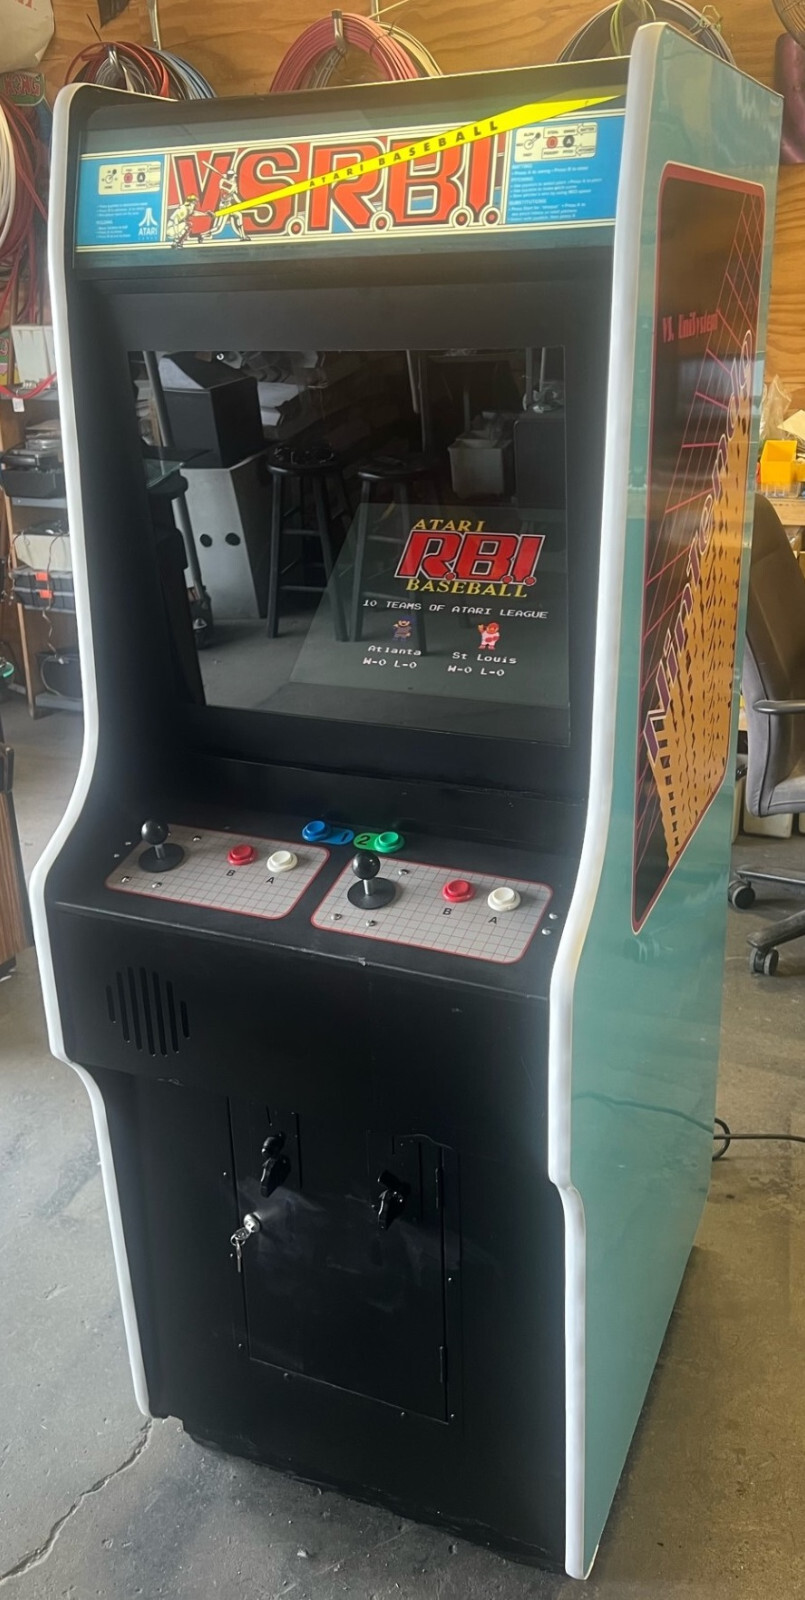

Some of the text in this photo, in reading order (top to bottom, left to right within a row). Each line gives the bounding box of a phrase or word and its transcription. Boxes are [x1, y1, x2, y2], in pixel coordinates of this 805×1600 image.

[309, 120, 498, 187] ATARI BASEBALL
[138, 228, 158, 236] ATARI
[412, 518, 486, 532] ATARI
[406, 579, 528, 598] BASEBALL
[386, 601, 422, 610] TEAMS
[451, 606, 492, 615] ATARI
[500, 609, 549, 618] LEAGUE
[368, 645, 422, 656] Atlanta
[452, 652, 518, 664] St Louis
[357, 834, 371, 846] 2
[226, 869, 275, 884] B A
[442, 907, 498, 924] B A
